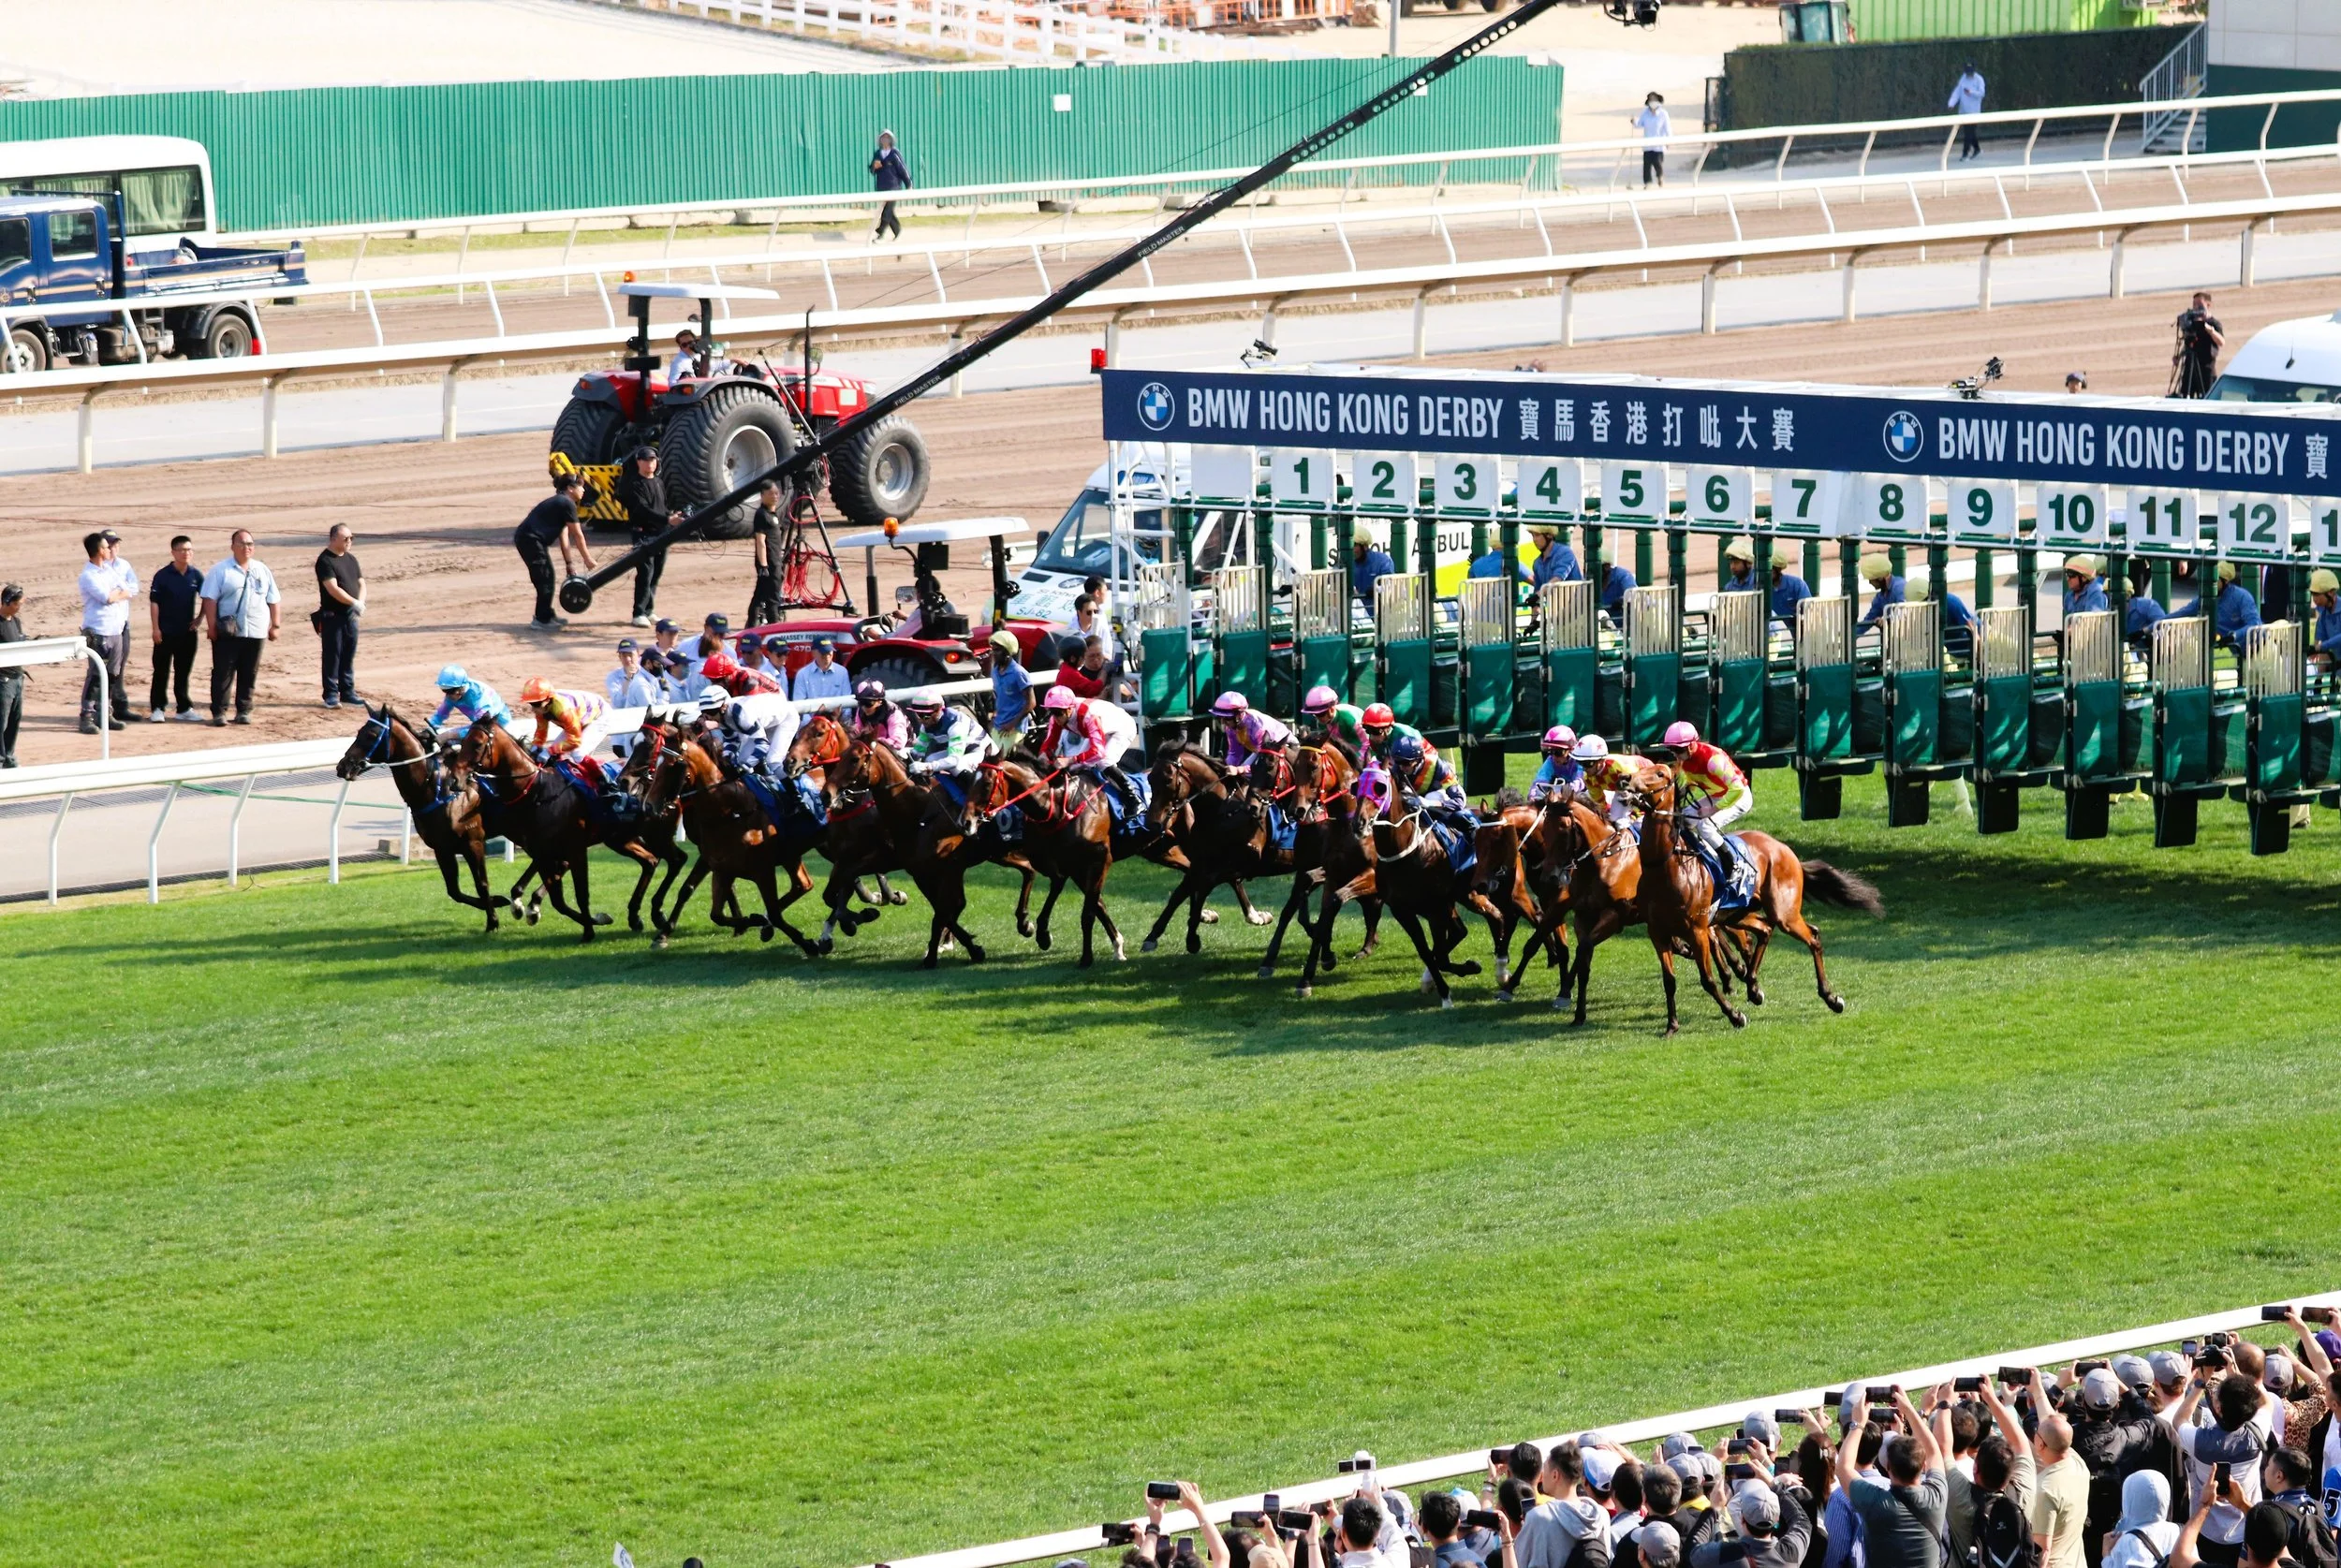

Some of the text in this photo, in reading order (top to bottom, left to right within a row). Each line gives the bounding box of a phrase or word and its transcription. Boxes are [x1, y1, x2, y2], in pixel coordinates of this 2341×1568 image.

[1138, 226, 1185, 257] FIELD MASTER
[894, 375, 942, 406] FIELD MASTER
[1188, 388, 1504, 439] BMW HONG KONG DERBY
[1939, 418, 2290, 476] BMW HONG KONG DERBY
[2305, 432, 2329, 479] 寶
[1293, 457, 1309, 494] 1
[1372, 461, 1396, 499] 2
[1453, 462, 1477, 501] 3
[1536, 466, 1562, 505] 4
[1619, 469, 1644, 507] 5
[1705, 475, 1730, 513] 6
[1791, 478, 1817, 518] 7
[1878, 483, 1905, 522] 8
[1966, 488, 1994, 527] 9
[2048, 493, 2095, 534] 10
[2139, 495, 2183, 537] 11
[2229, 503, 2276, 544] 12
